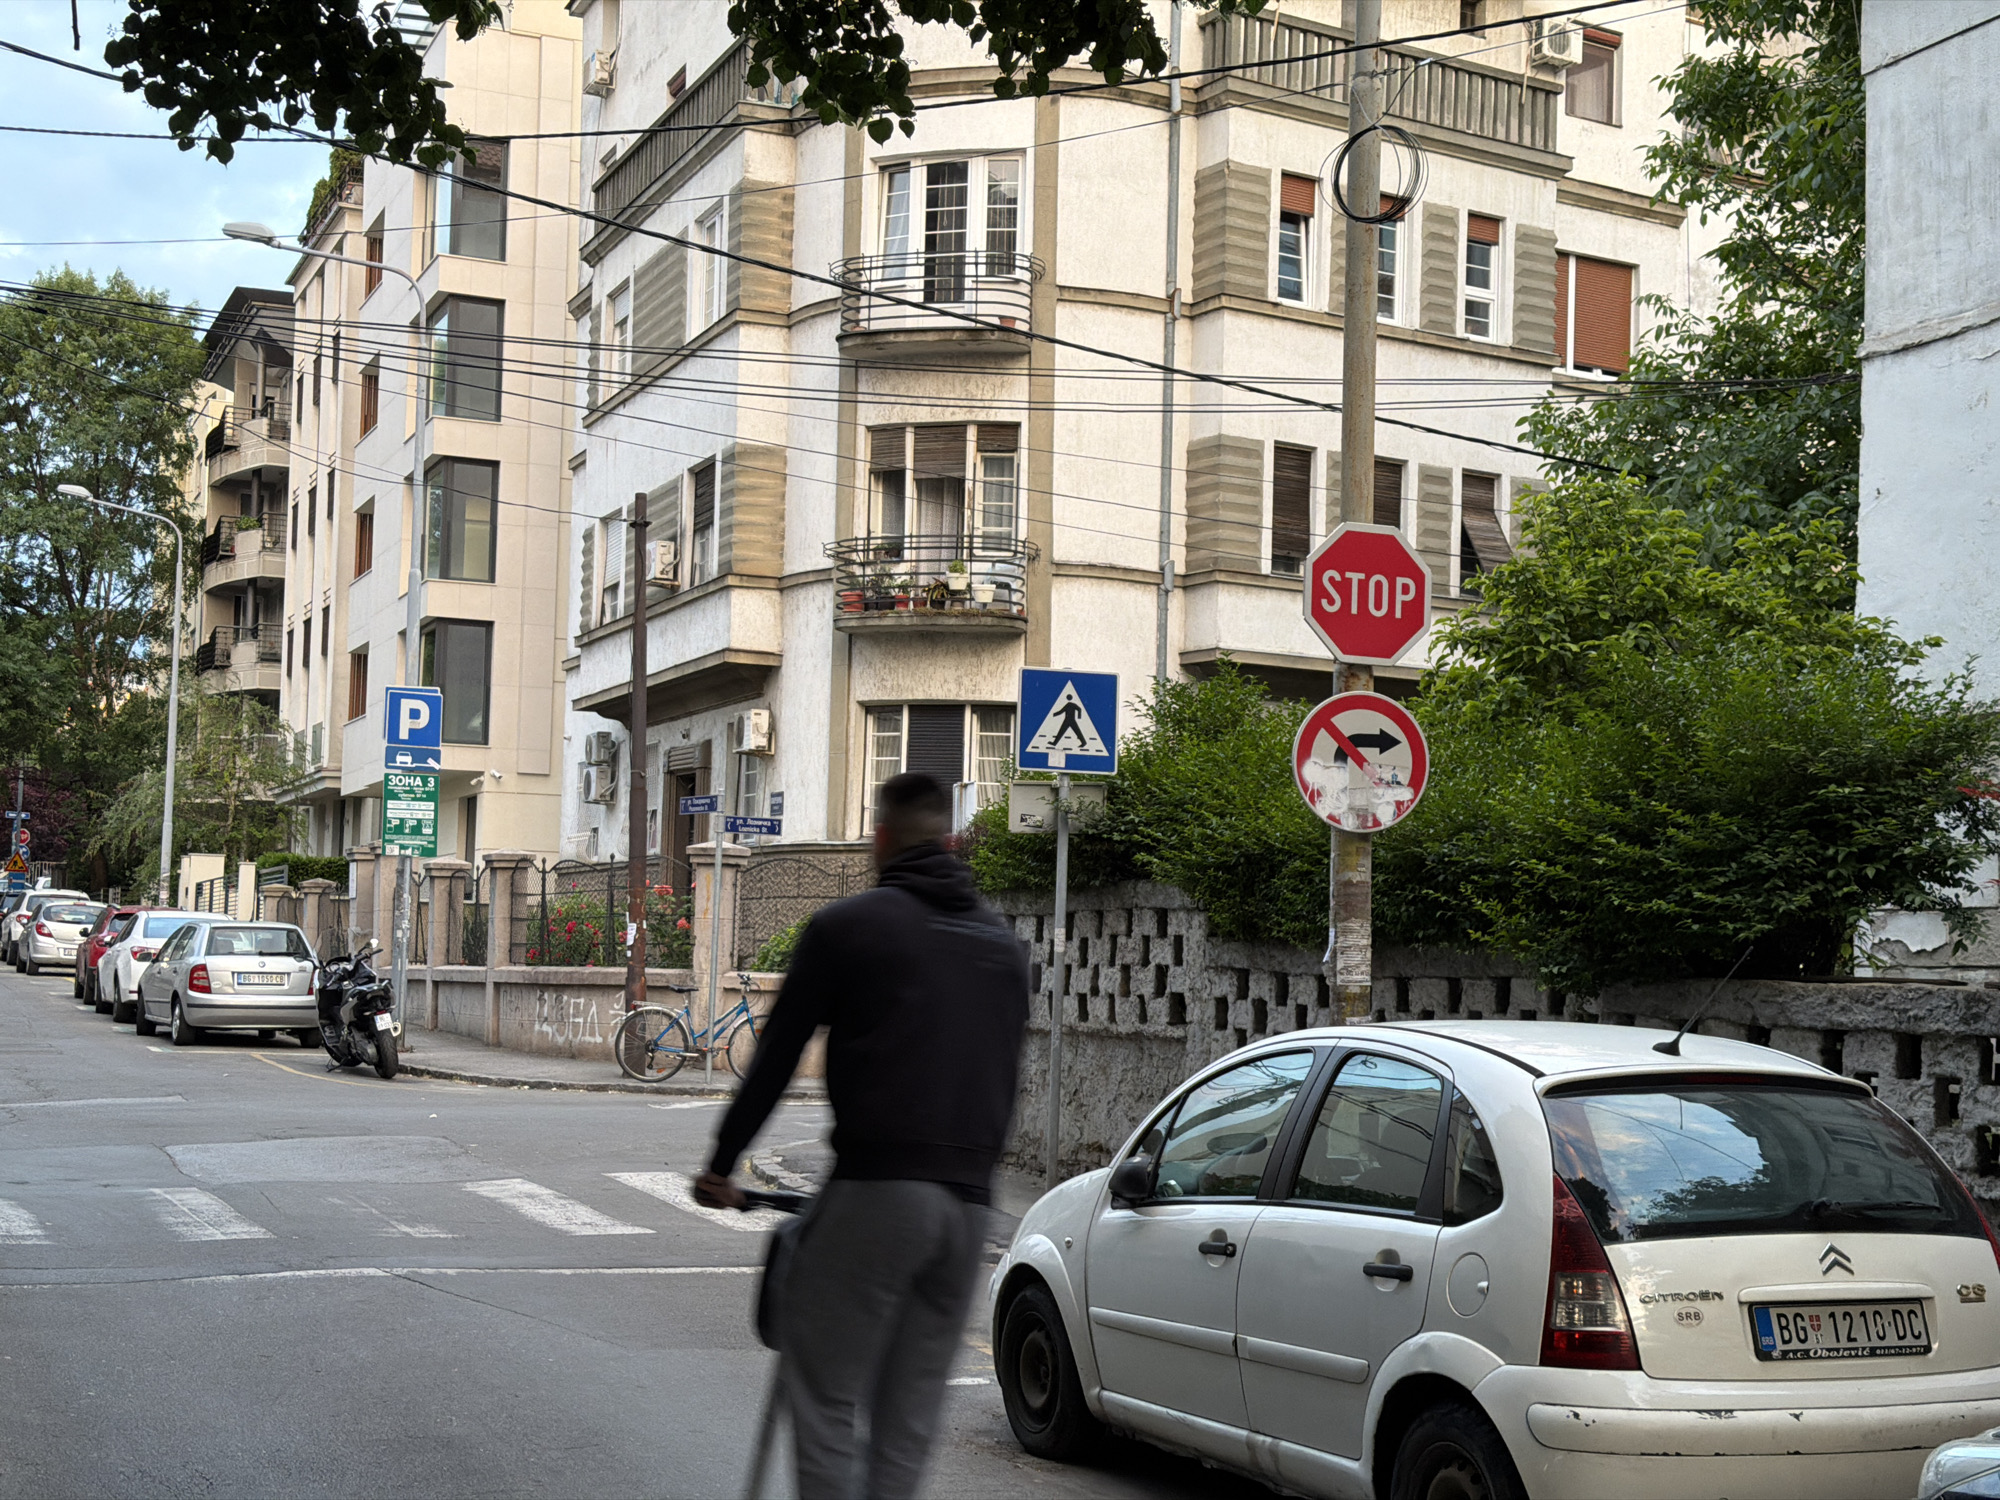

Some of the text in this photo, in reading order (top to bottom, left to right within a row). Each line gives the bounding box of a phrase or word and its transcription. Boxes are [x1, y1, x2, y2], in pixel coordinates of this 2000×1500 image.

[1321, 569, 1416, 619] STOP
[399, 698, 430, 740] P
[388, 775, 435, 788] ЗОНА 3
[242, 974, 252, 983] BG
[1639, 1289, 1724, 1304] CITROËN
[1677, 1311, 1701, 1322] SRB
[1776, 1312, 1809, 1345] BG
[1786, 1351, 1807, 1359] A.C.
[1809, 1347, 1870, 1358] Obojević
